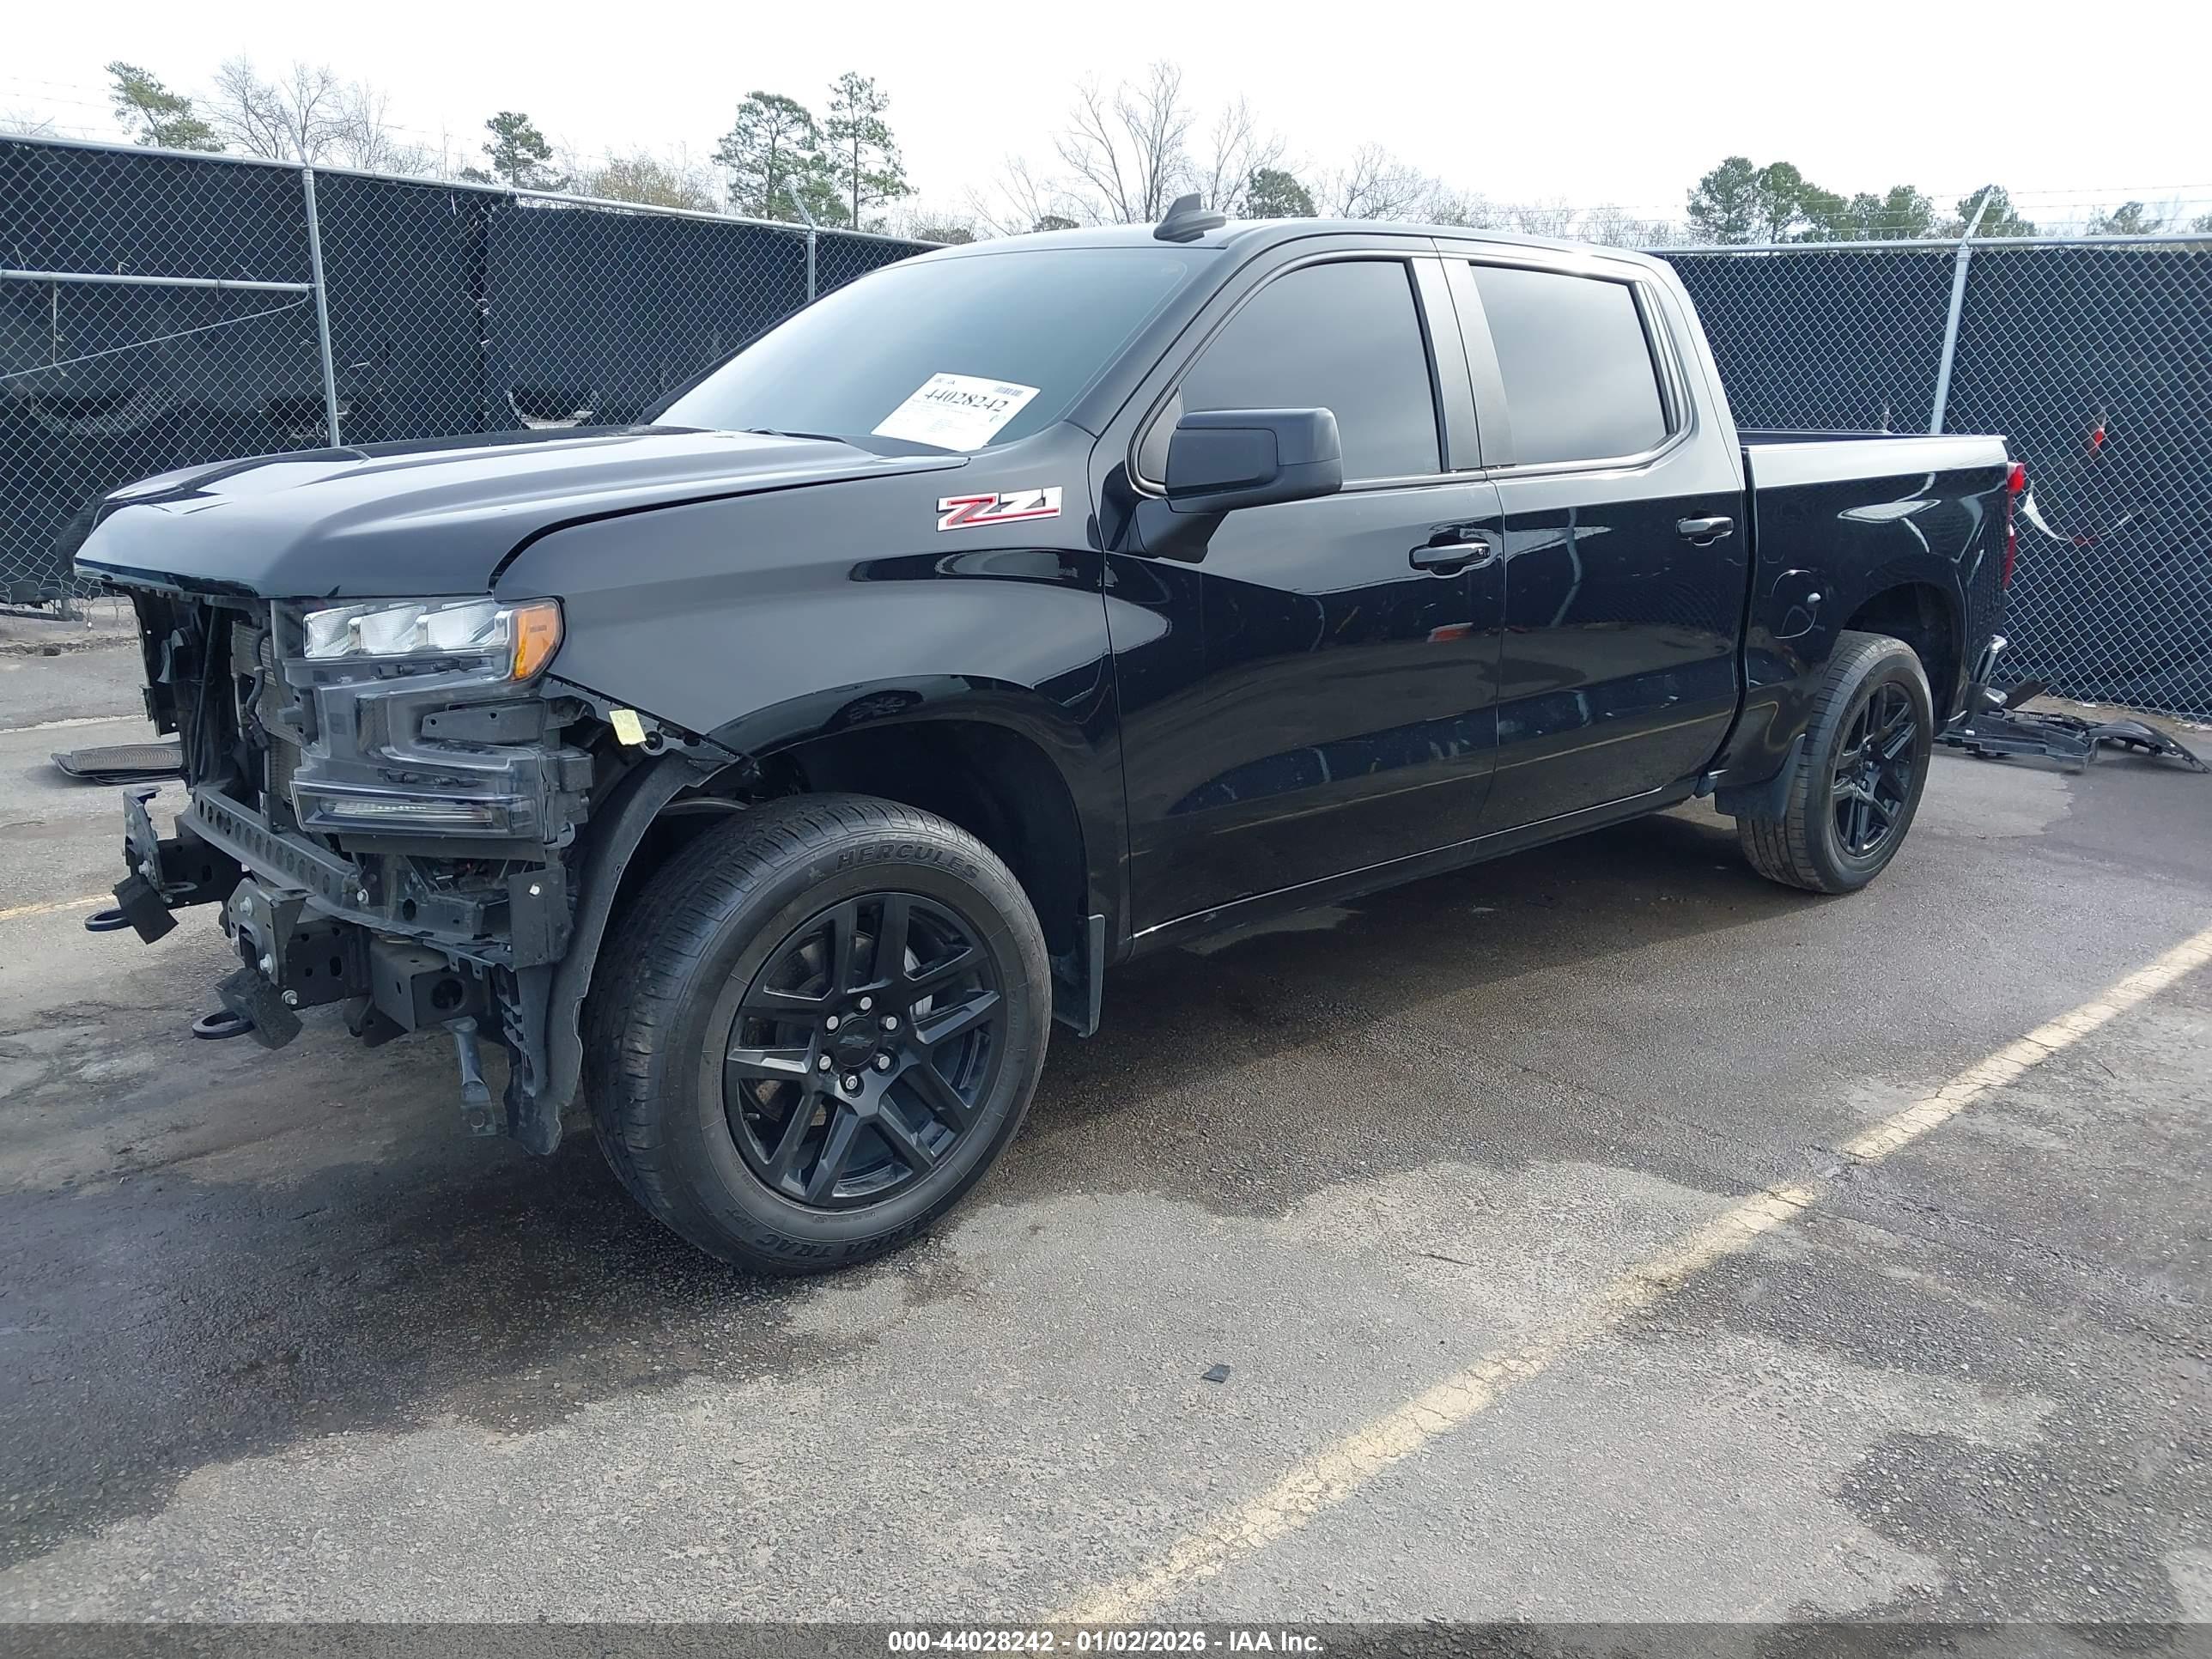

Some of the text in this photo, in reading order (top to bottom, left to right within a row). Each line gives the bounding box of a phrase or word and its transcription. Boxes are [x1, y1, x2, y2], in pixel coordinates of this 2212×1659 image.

[924, 388, 1009, 412] 44028242
[936, 486, 1062, 532] Z71
[836, 844, 981, 880] HERCULES
